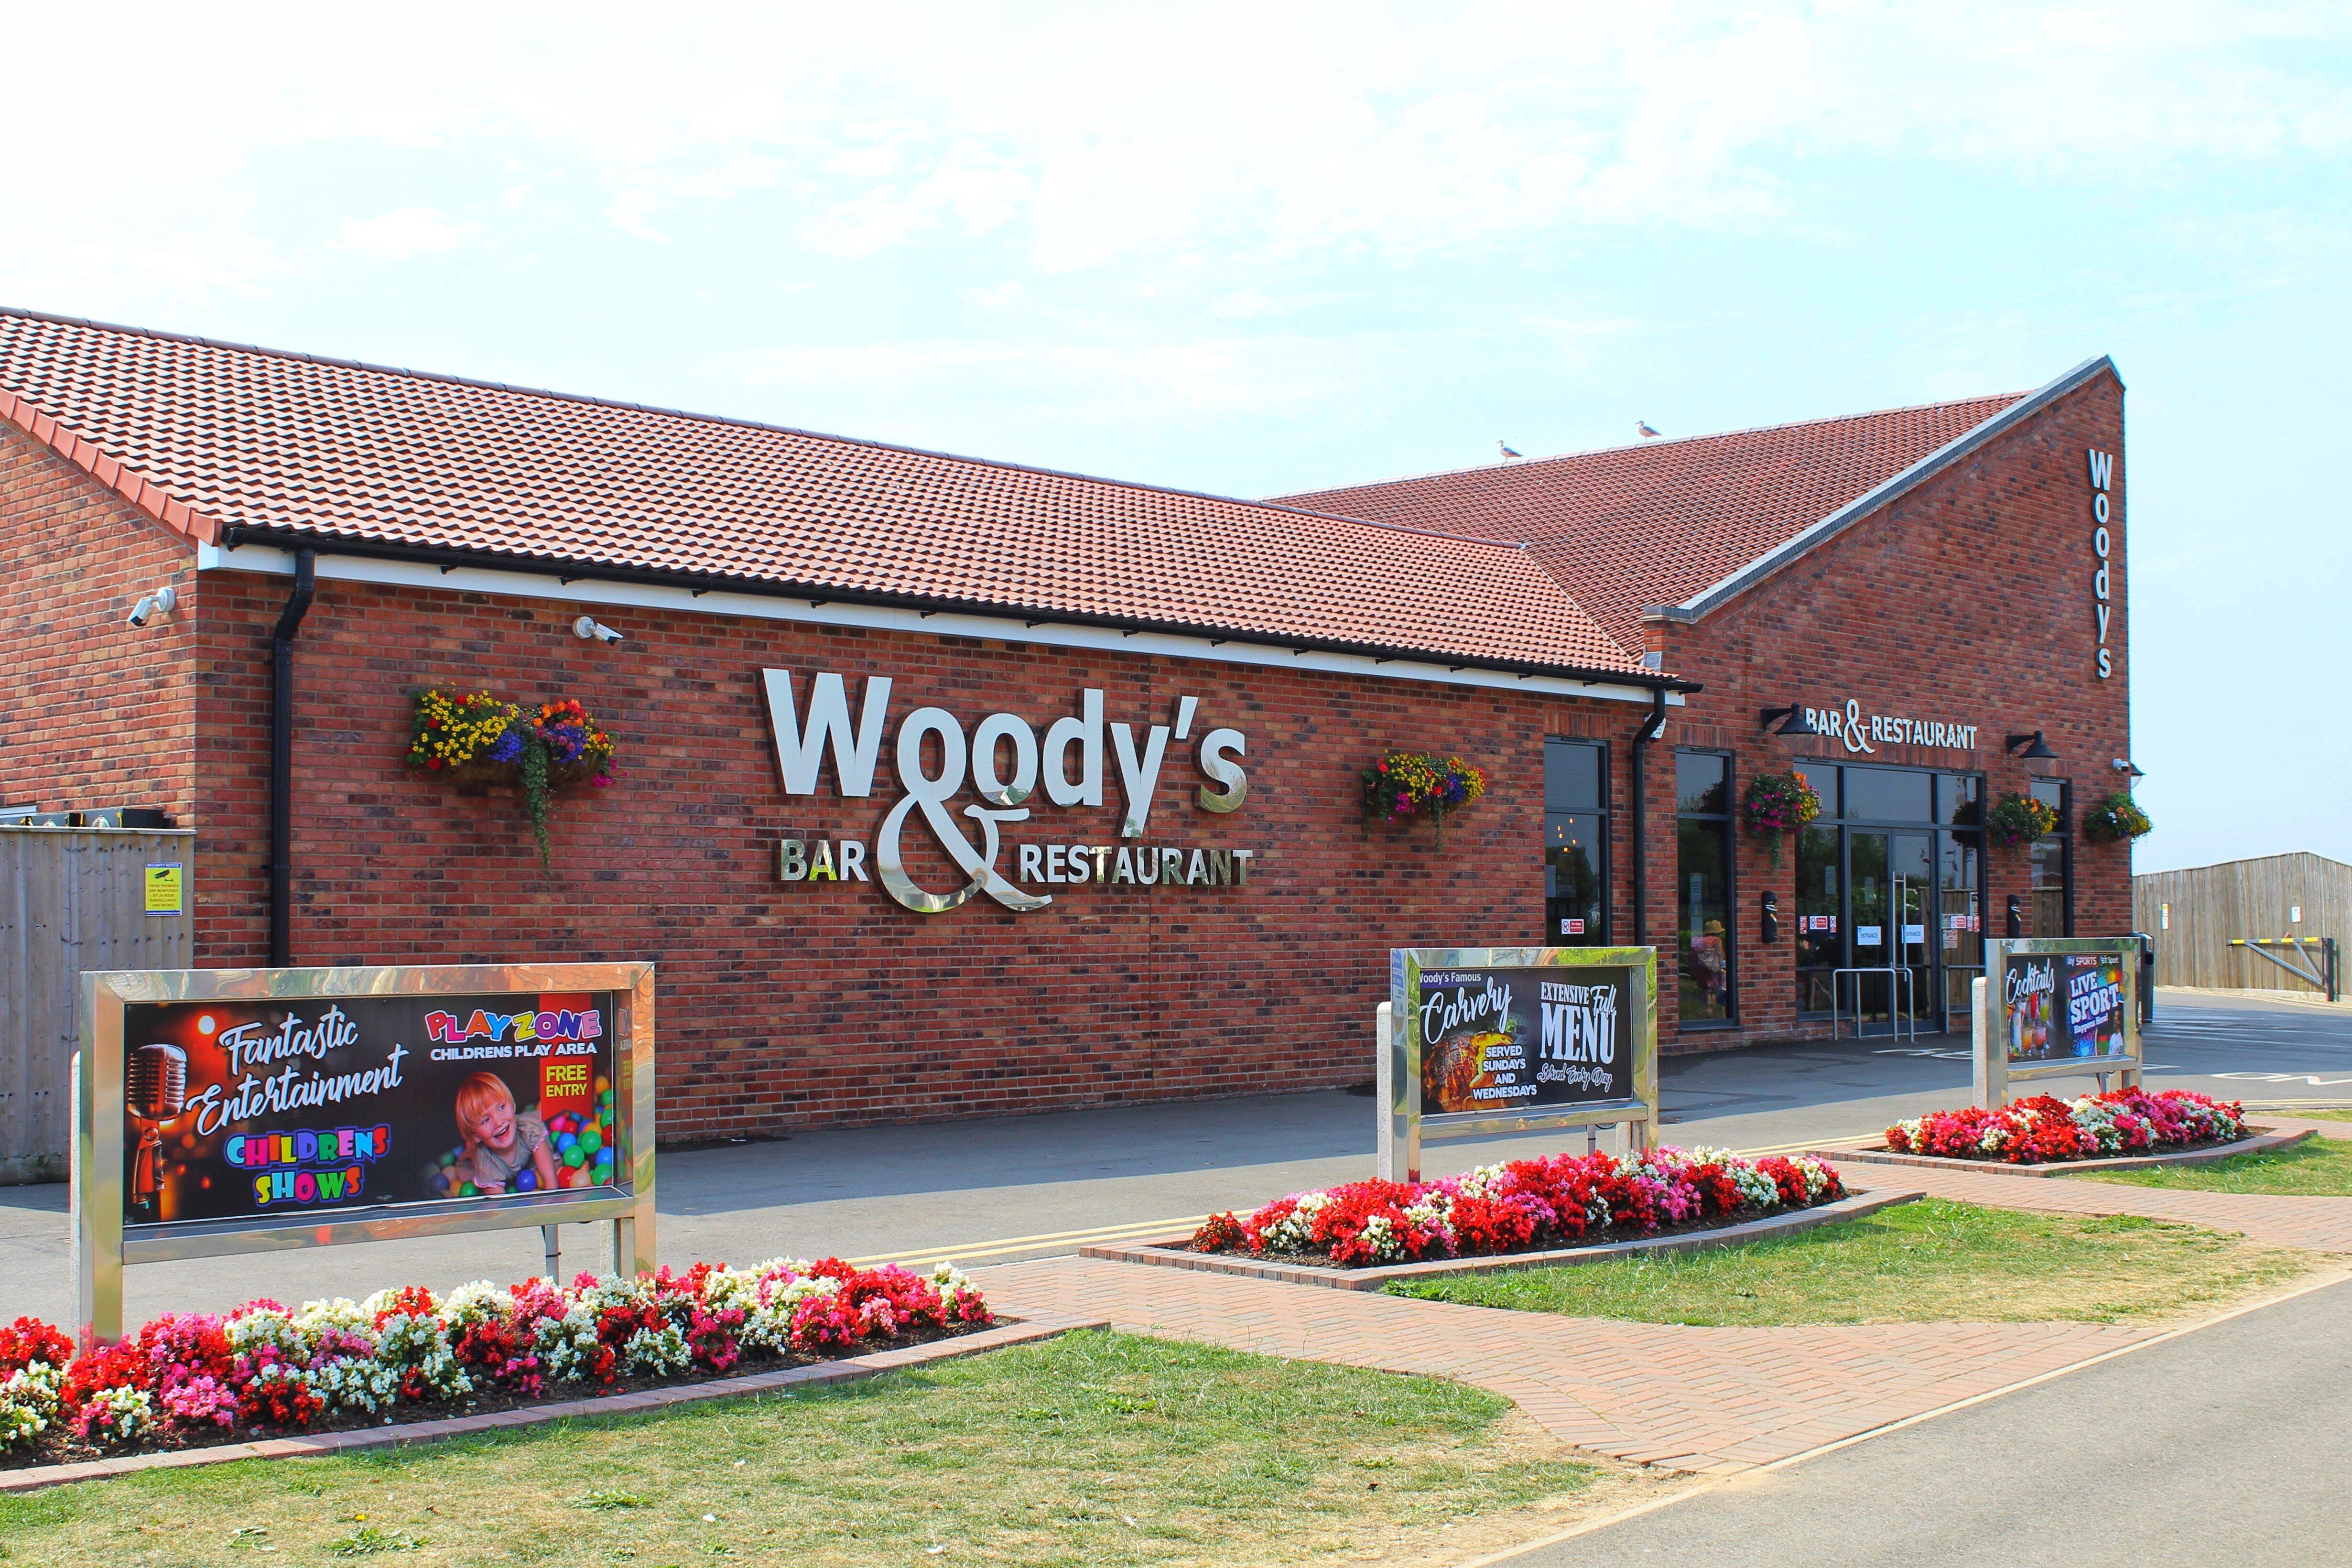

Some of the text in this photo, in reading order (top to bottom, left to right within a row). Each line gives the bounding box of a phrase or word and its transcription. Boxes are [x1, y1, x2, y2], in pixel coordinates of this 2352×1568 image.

[2088, 448, 2113, 679] Woodys
[1806, 698, 1978, 754] BAR & RESTAURANT
[762, 668, 1246, 838] Woody's
[780, 707, 1253, 913] BAR & RESTAURANT
[1451, 972, 1481, 983] Famous
[2075, 957, 2097, 965] SPORTS
[2108, 956, 2119, 965] Sport
[2005, 957, 2054, 1004] Cocktails
[2070, 971, 2098, 998] LIVE
[1420, 976, 1513, 1044] Carvery
[1540, 982, 1617, 1019] EXTENSIVE Full
[2070, 983, 2119, 1025] SPORT
[218, 1003, 359, 1076] Fantastic
[1540, 1002, 1617, 1064] MENU
[2074, 1020, 2096, 1034] Happens
[430, 1042, 597, 1061] CHILDRENS PLAY AREA
[1483, 1058, 1526, 1072] SUNDAYS
[1485, 1045, 1523, 1058] SERVED
[185, 1043, 411, 1136] Entertainment
[546, 1064, 587, 1082] FREE
[1494, 1072, 1516, 1085] AND
[1536, 1062, 1613, 1093] Served Every Day
[546, 1083, 588, 1098] ENTRY
[1472, 1084, 1538, 1100] WEDNESDAYS
[225, 1126, 389, 1167] CHILDRENS
[255, 1166, 362, 1204] SHOWS
